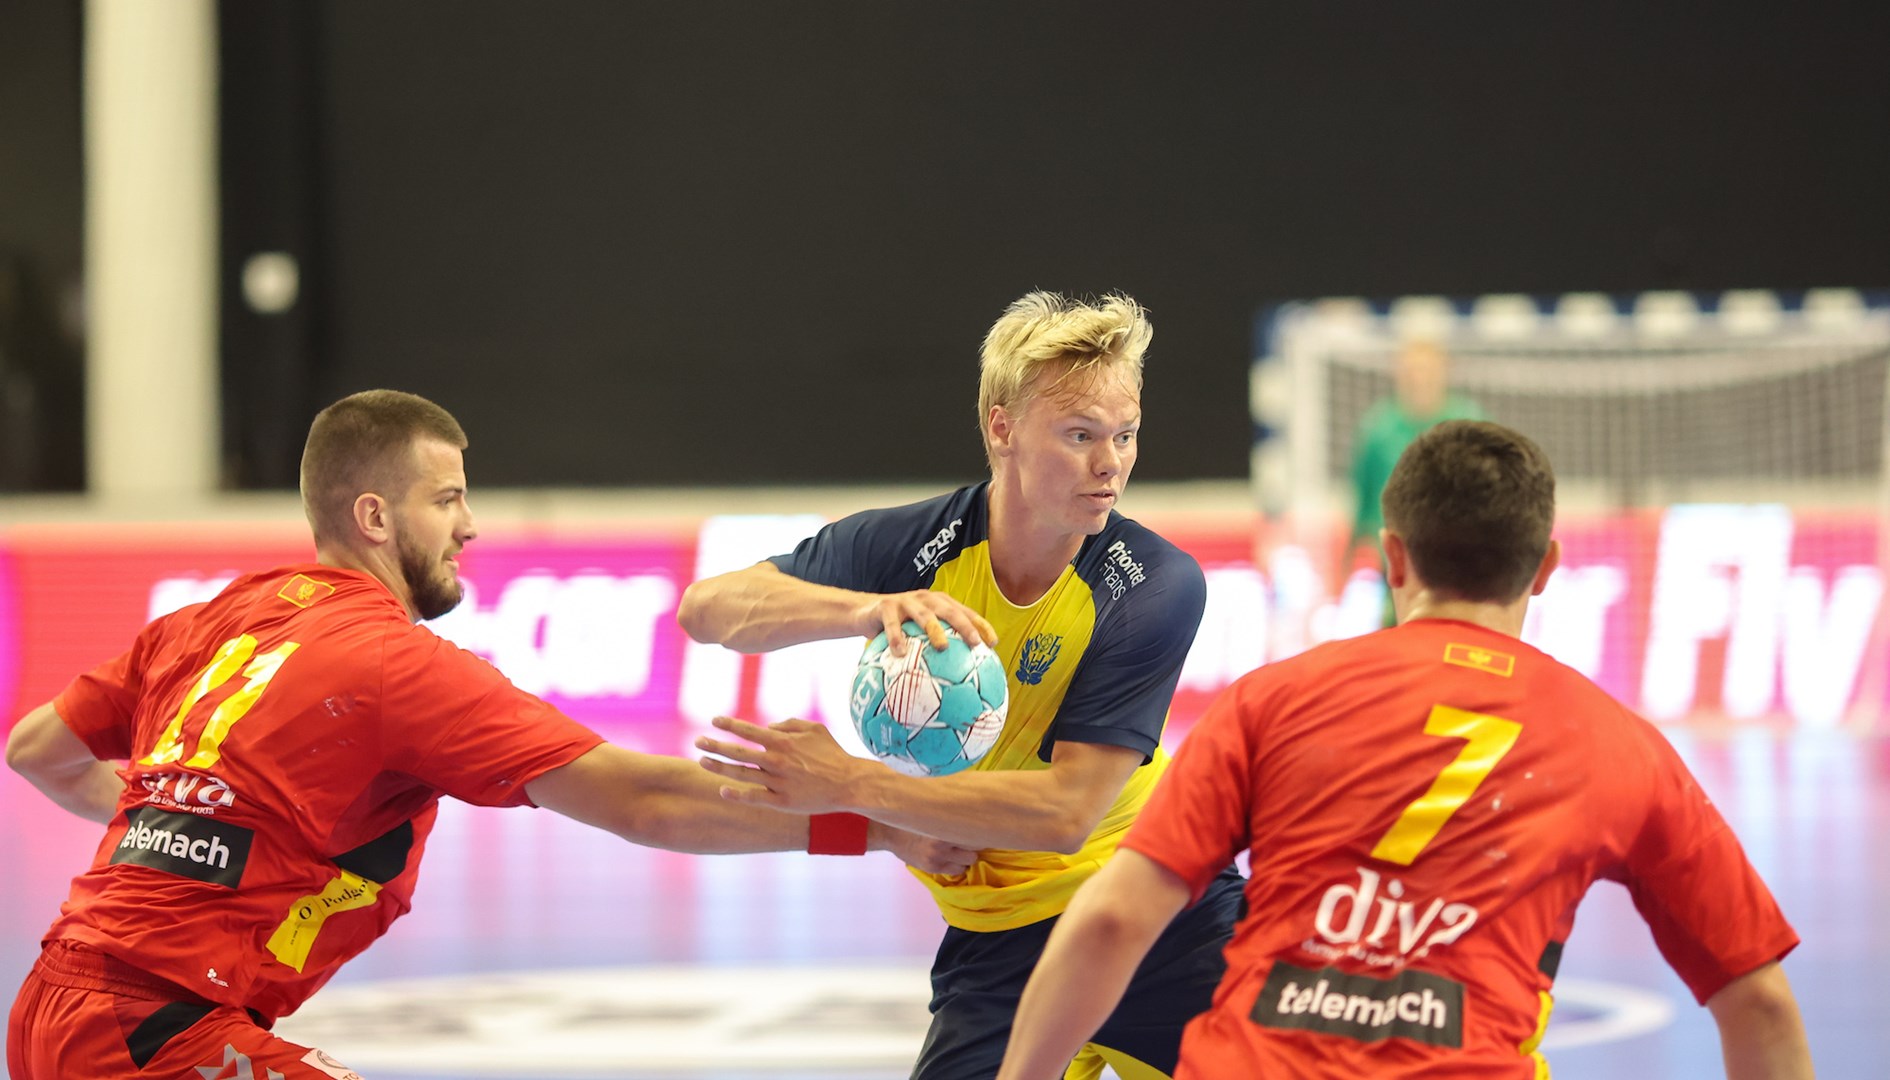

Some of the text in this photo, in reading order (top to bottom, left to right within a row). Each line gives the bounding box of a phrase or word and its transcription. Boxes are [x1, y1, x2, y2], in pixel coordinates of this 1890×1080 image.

[137, 633, 302, 769] 11
[1370, 703, 1523, 866] 7
[119, 820, 230, 869] elemach
[1276, 979, 1447, 1029] telemach
